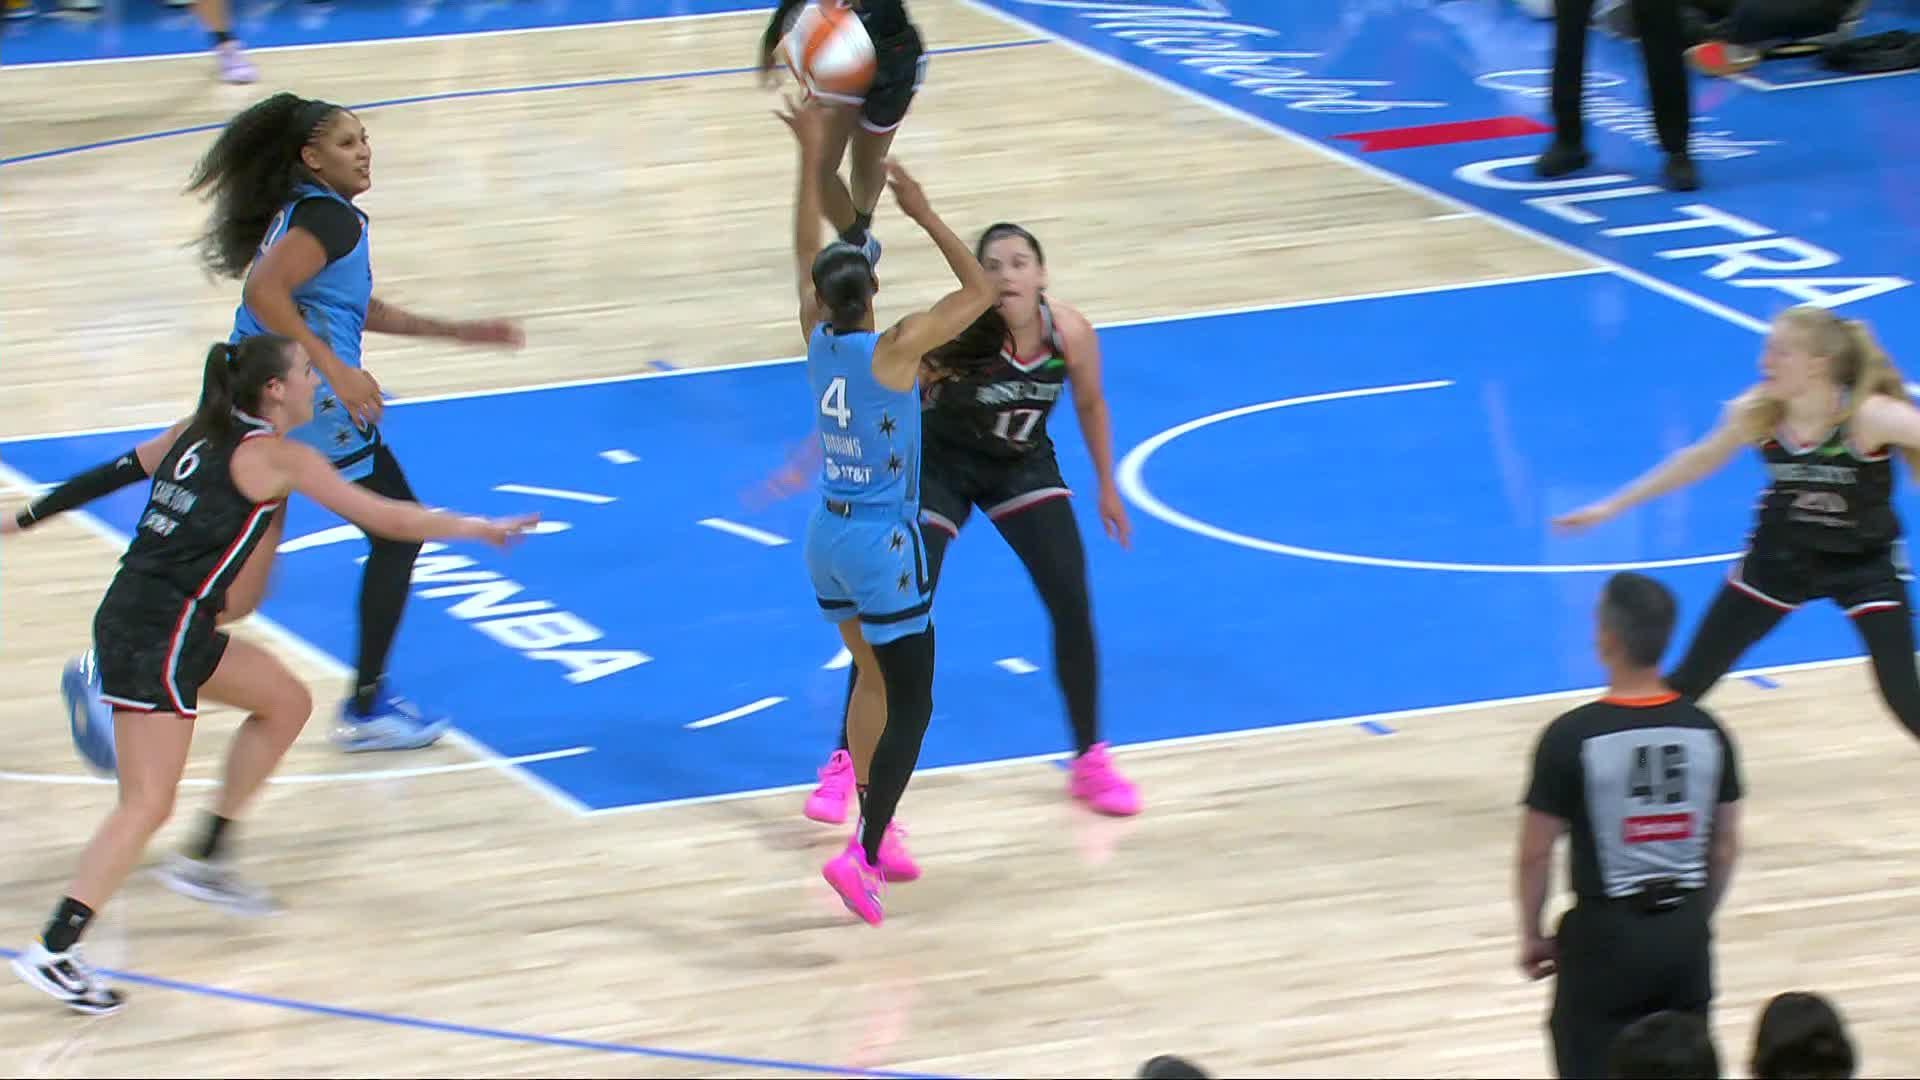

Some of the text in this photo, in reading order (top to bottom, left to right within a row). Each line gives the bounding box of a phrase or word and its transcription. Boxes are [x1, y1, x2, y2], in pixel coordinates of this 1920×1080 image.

[1453, 154, 1914, 309] ULTRA
[820, 376, 852, 429] 4
[992, 408, 1044, 441] 17
[173, 438, 208, 481] 6
